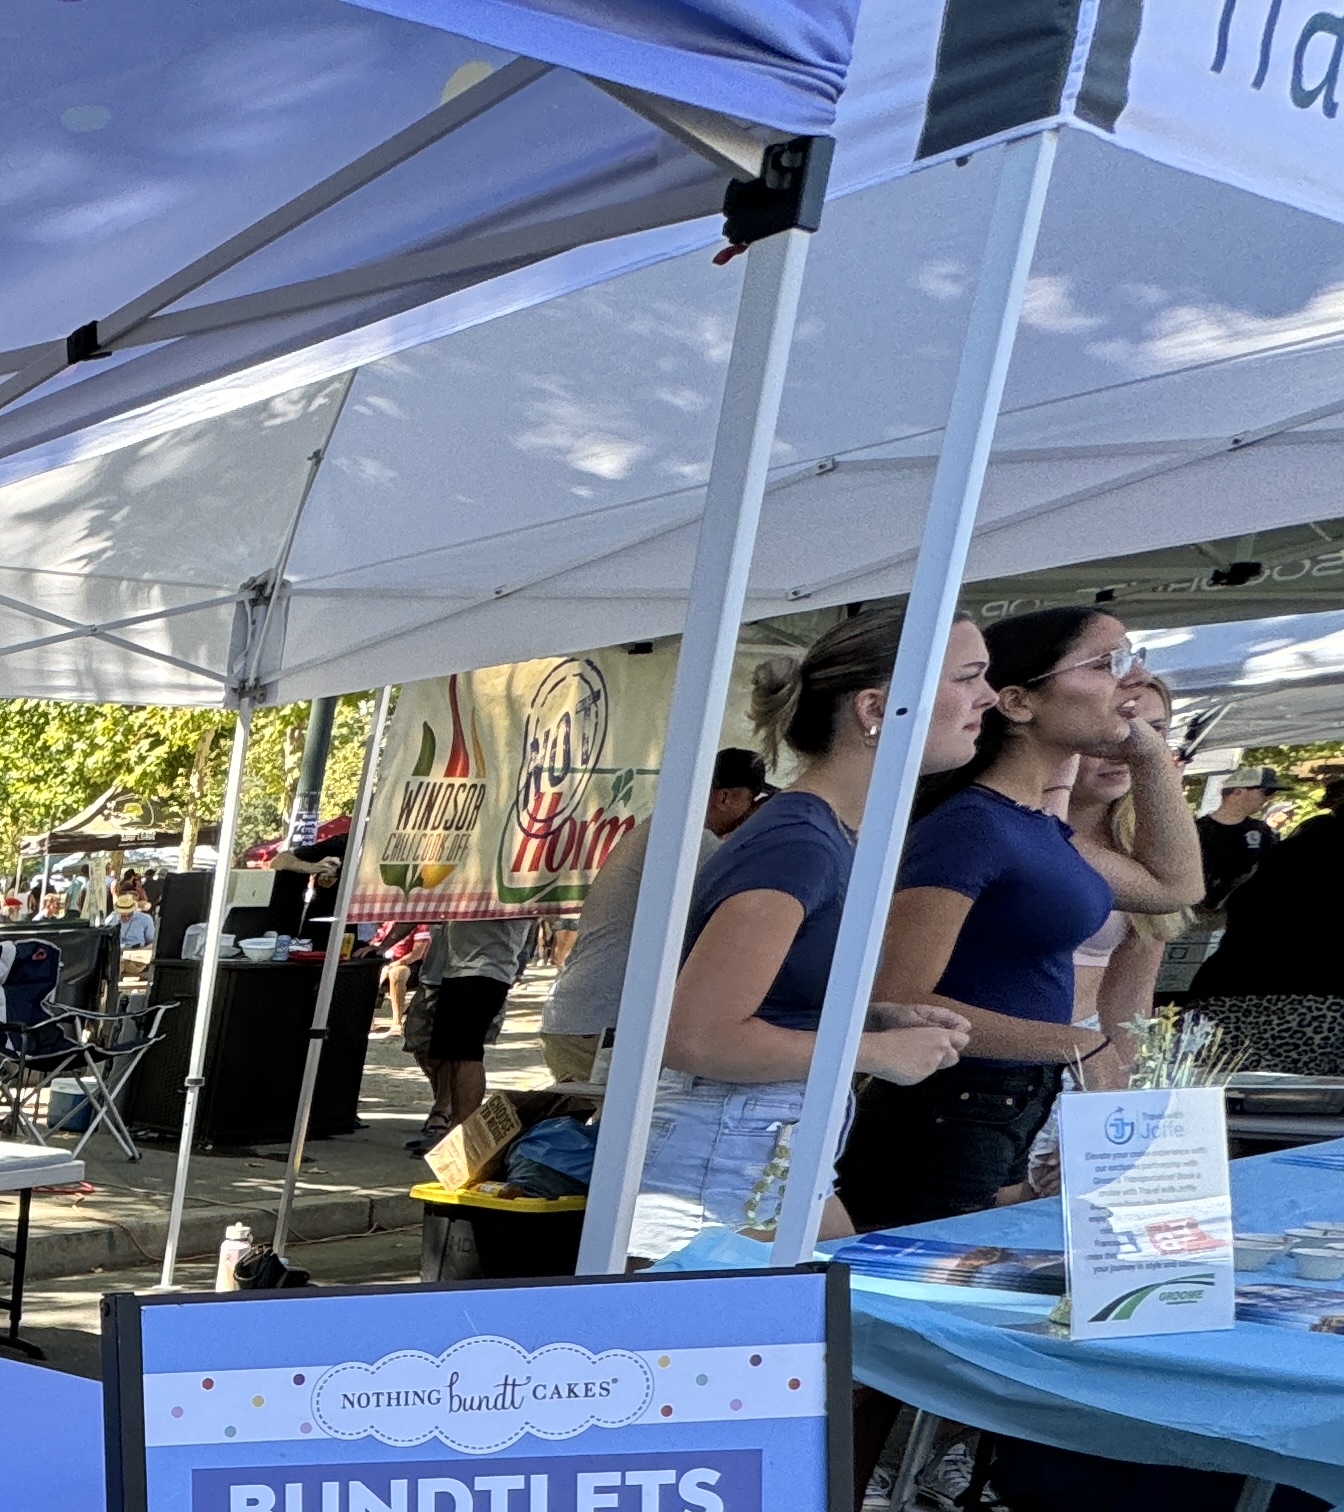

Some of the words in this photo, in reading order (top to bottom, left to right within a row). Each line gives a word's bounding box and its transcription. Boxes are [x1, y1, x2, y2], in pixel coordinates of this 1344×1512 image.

[395, 780, 487, 832] WINDSOR
[489, 1095, 515, 1135] CHOOSE
[340, 1389, 442, 1410] NOTHING
[443, 1371, 532, 1414] bundt
